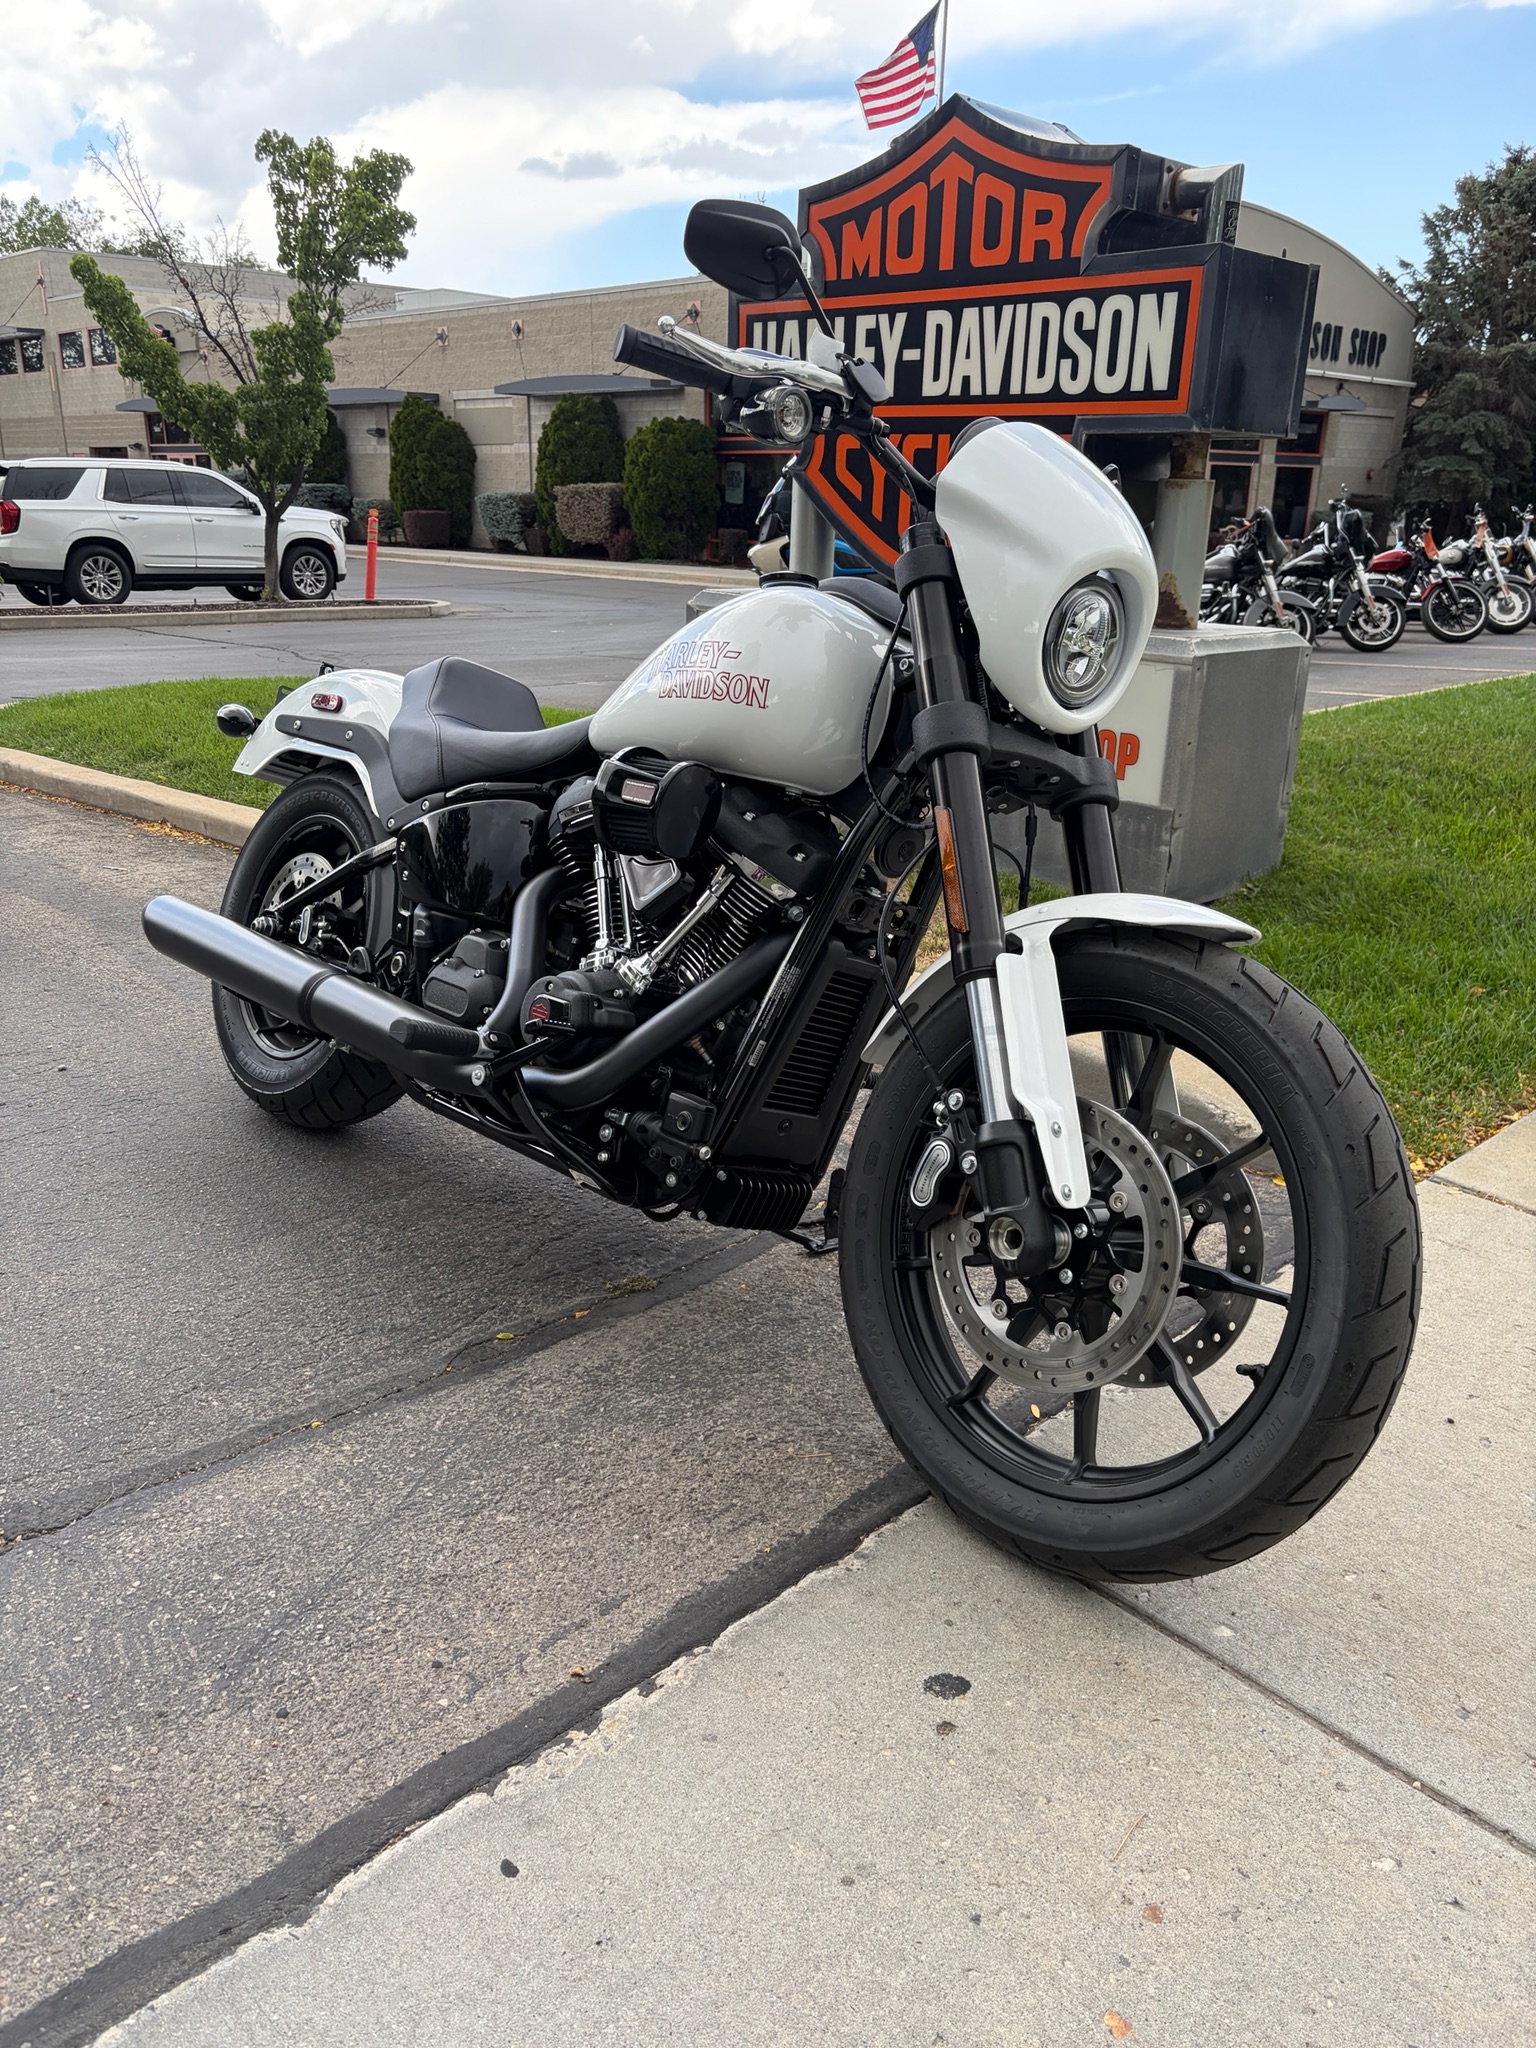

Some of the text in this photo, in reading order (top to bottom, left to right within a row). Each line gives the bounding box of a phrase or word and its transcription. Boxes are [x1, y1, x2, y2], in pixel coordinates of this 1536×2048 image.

[842, 151, 1064, 280] MOTOR
[753, 291, 1179, 398] EY-DAVIDSON
[1348, 327, 1387, 368] SHOP
[659, 670, 770, 709] DAVIDSON
[236, 1049, 281, 1083] MICHELIN
[1180, 988, 1298, 1108] MICHELIN
[883, 1058, 923, 1120] SCORCHE
